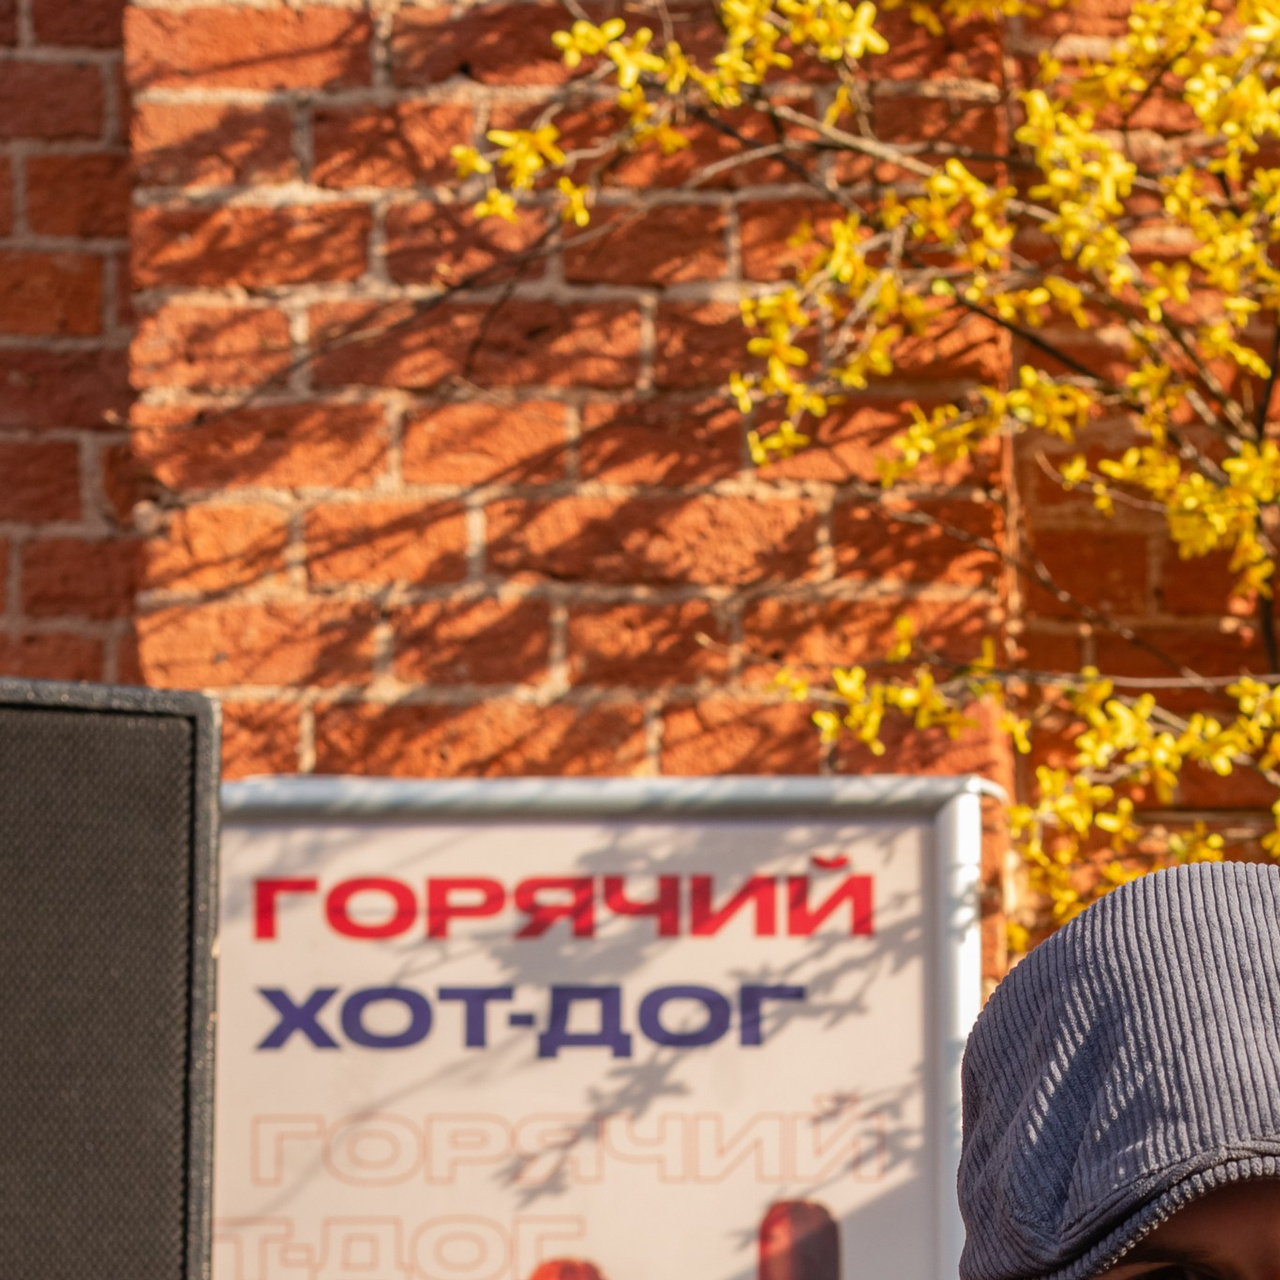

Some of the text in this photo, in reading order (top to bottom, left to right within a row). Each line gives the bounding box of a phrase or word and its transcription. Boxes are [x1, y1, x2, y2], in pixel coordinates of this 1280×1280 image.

[251, 855, 876, 941] ГОРЯЧИЙ
[256, 984, 806, 1059] ХОТ-ДОГ
[251, 1095, 888, 1187] ГОРЯЧИЙ
